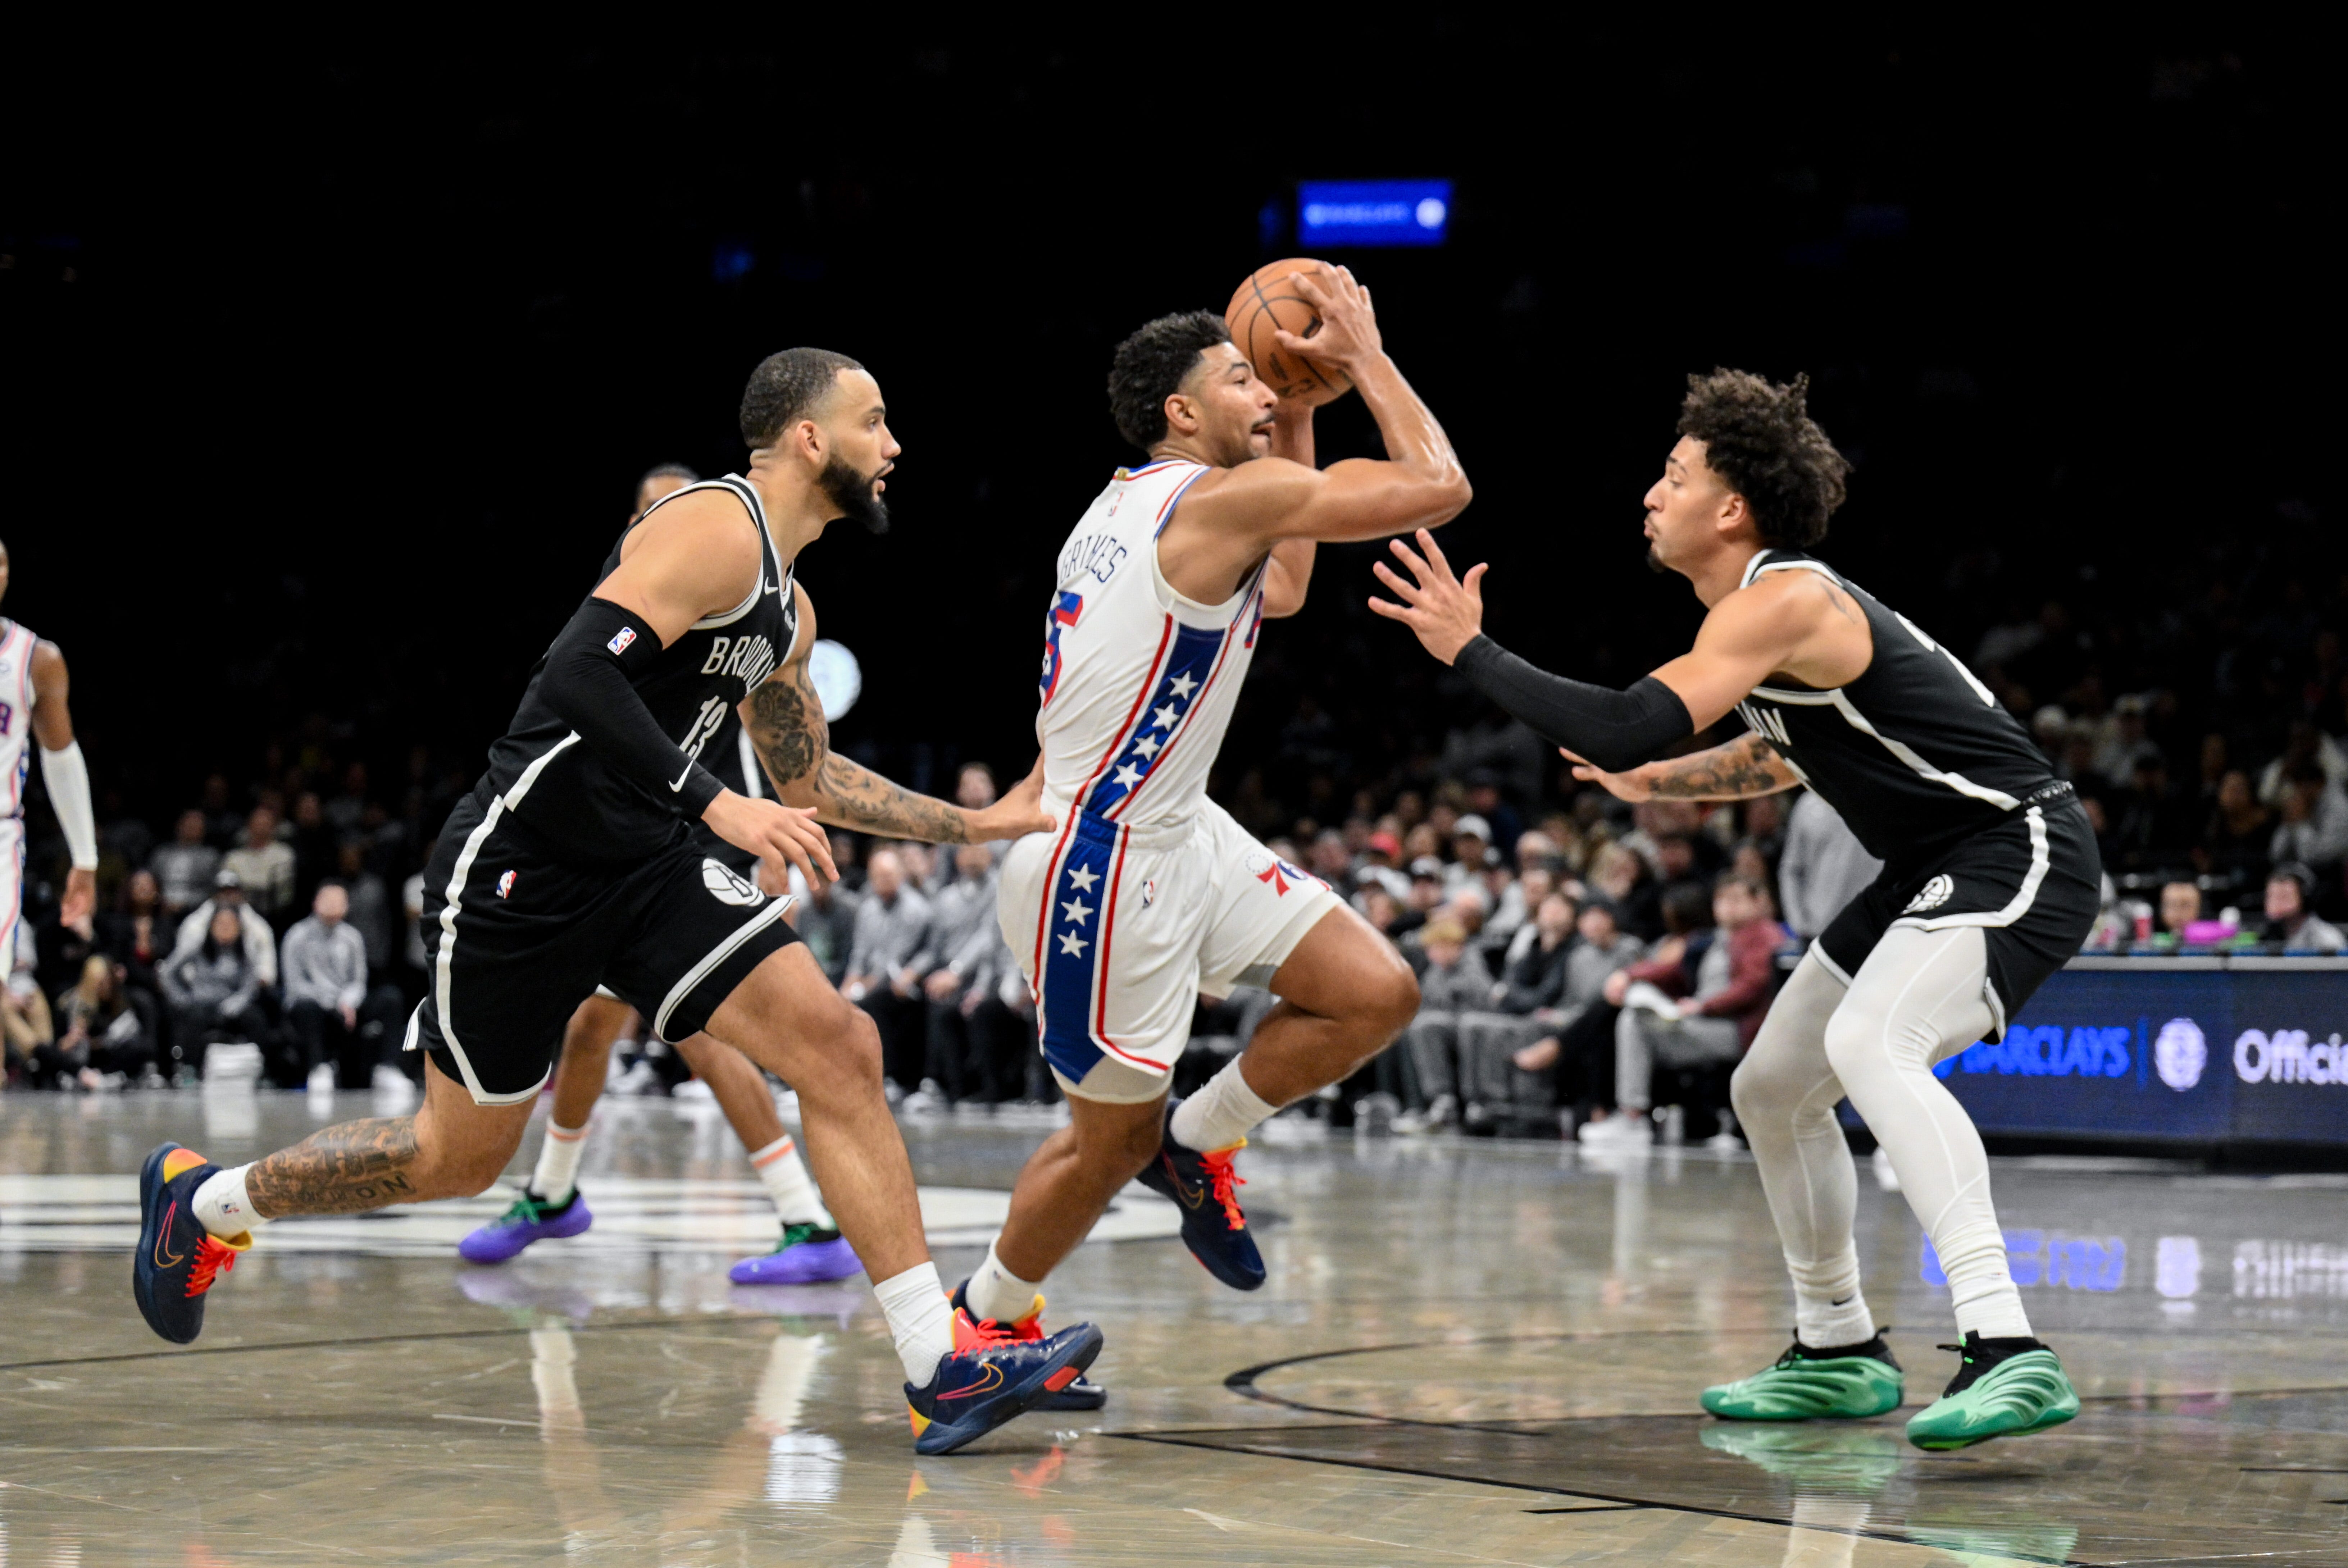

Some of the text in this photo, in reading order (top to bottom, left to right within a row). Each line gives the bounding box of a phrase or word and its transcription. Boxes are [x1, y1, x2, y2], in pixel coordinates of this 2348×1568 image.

[1060, 534, 1127, 583] GRIMES
[679, 695, 728, 761] 13
[2233, 1029, 2348, 1085] Offici
